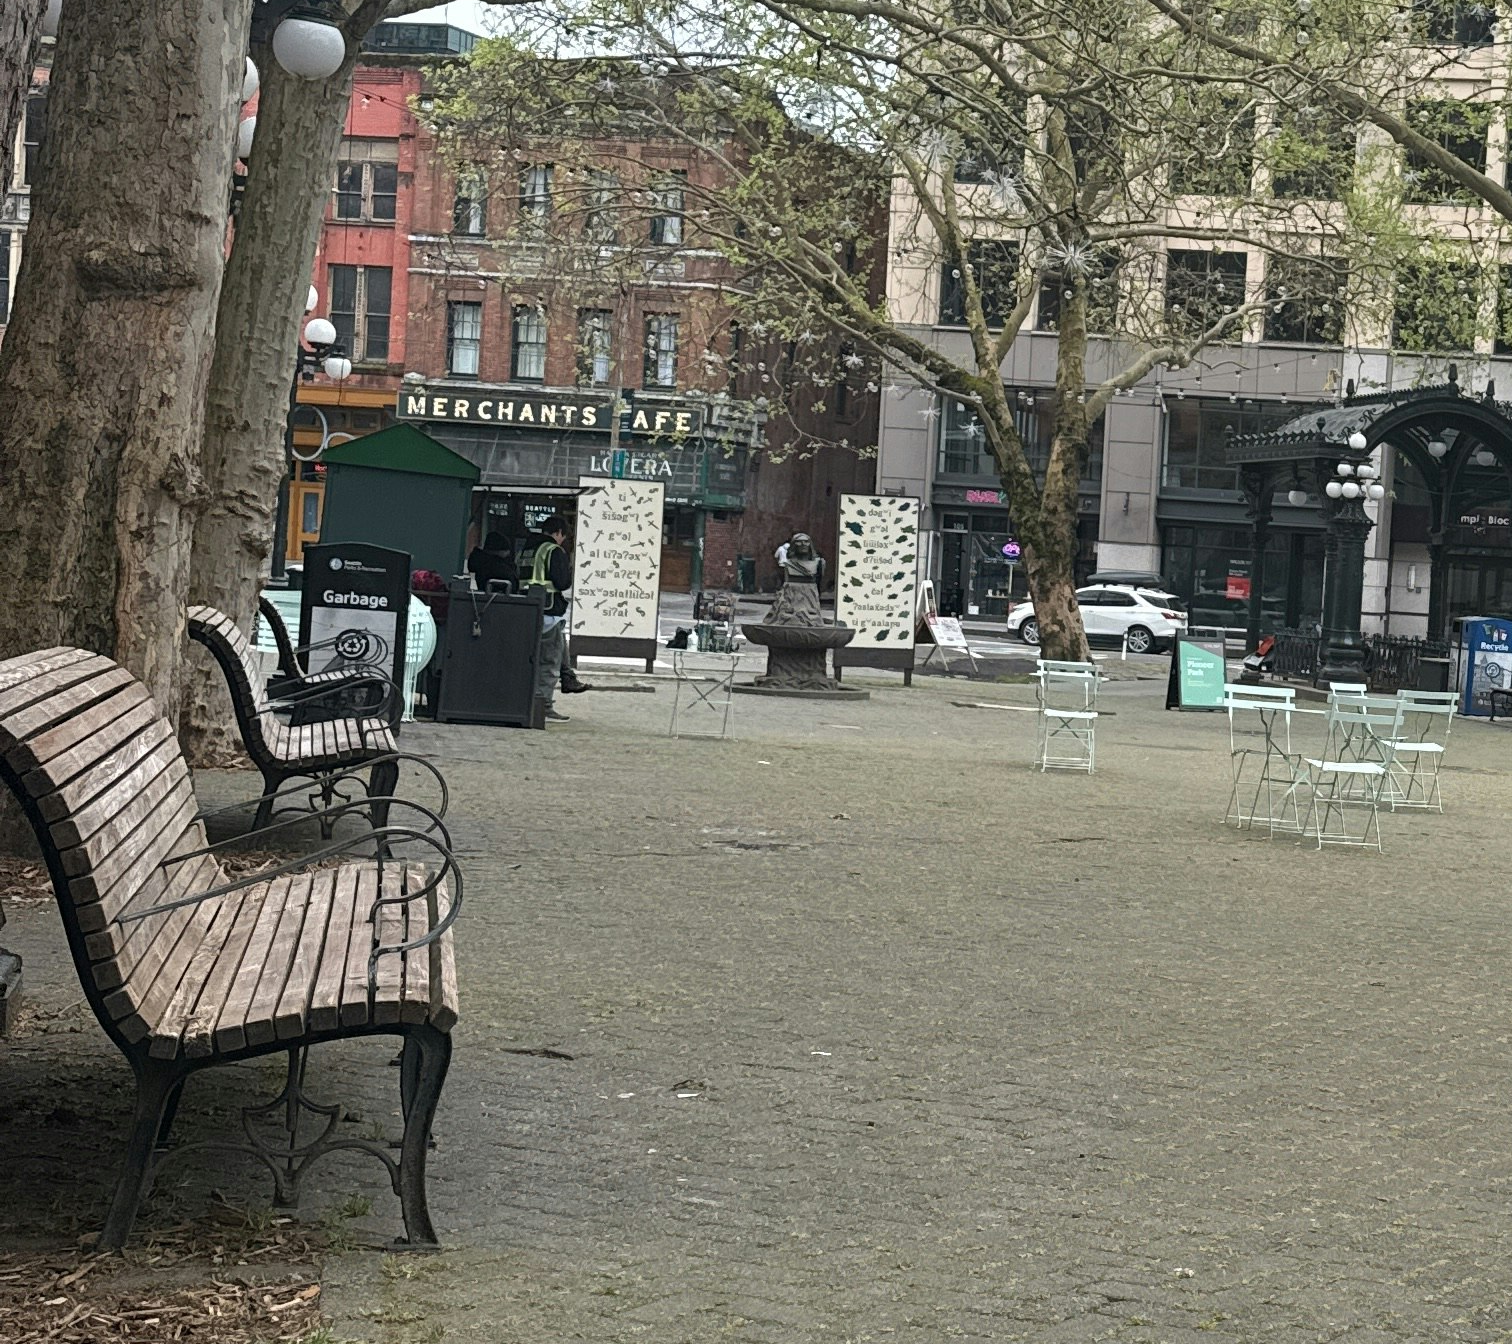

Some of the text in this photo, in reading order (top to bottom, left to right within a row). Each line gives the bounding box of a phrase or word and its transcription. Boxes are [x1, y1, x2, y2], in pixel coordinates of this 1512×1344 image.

[407, 396, 597, 426] MERCHANTS
[632, 411, 693, 432] AFE
[323, 589, 389, 609] Garbage
[1480, 641, 1510, 652] Recycle
